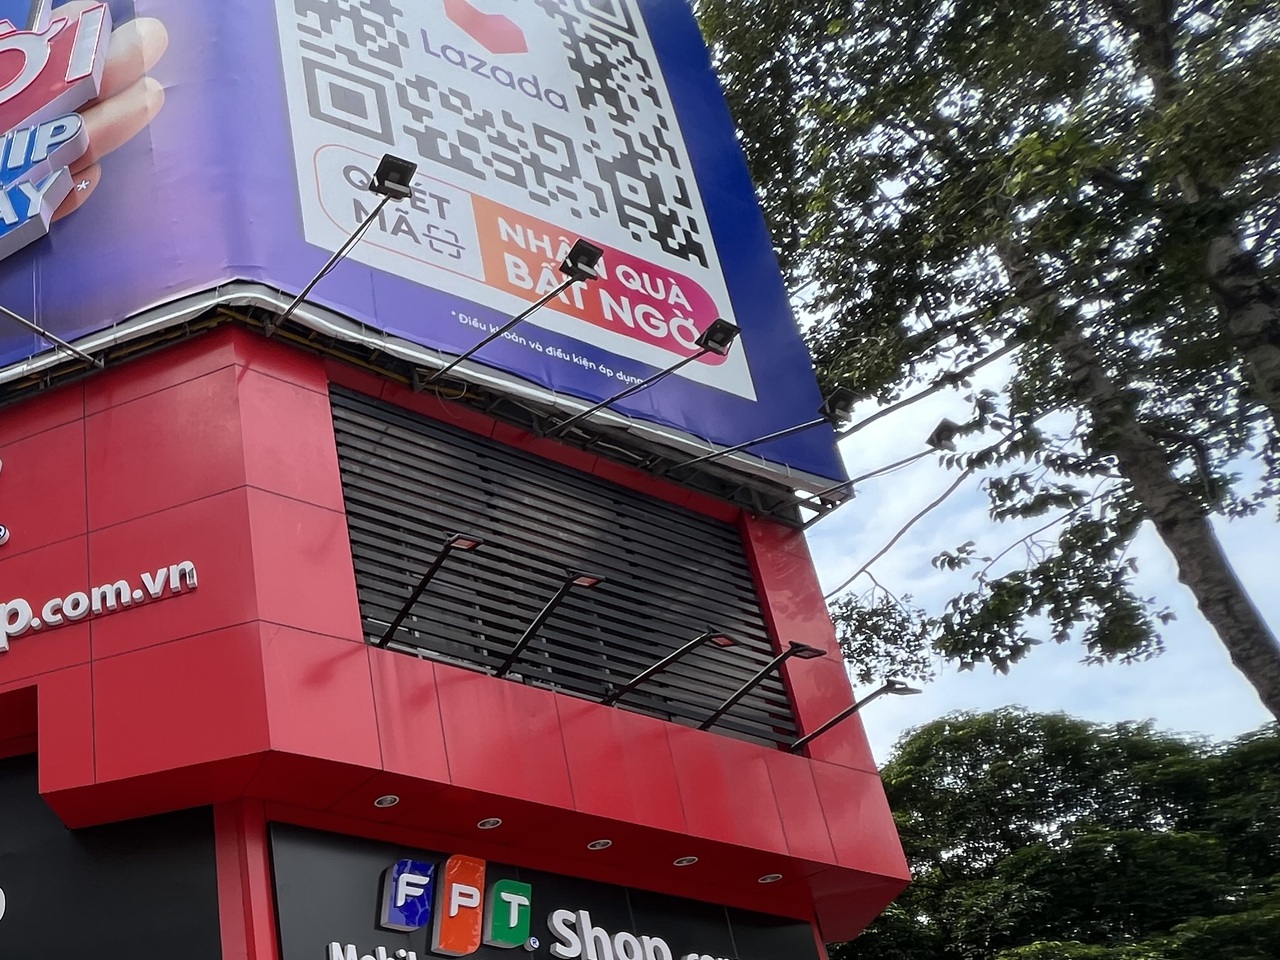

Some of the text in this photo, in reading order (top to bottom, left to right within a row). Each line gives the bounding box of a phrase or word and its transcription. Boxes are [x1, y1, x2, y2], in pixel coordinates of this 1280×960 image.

[420, 28, 570, 113] Lazada
[342, 164, 451, 221] QÉT
[352, 197, 422, 246] MÃ
[503, 251, 702, 351] BẤT NGỜ
[615, 264, 694, 312] QUÀ
[529, 340, 543, 352] và
[572, 353, 597, 370] kiện
[598, 363, 614, 378] áp
[394, 872, 531, 929] FPT
